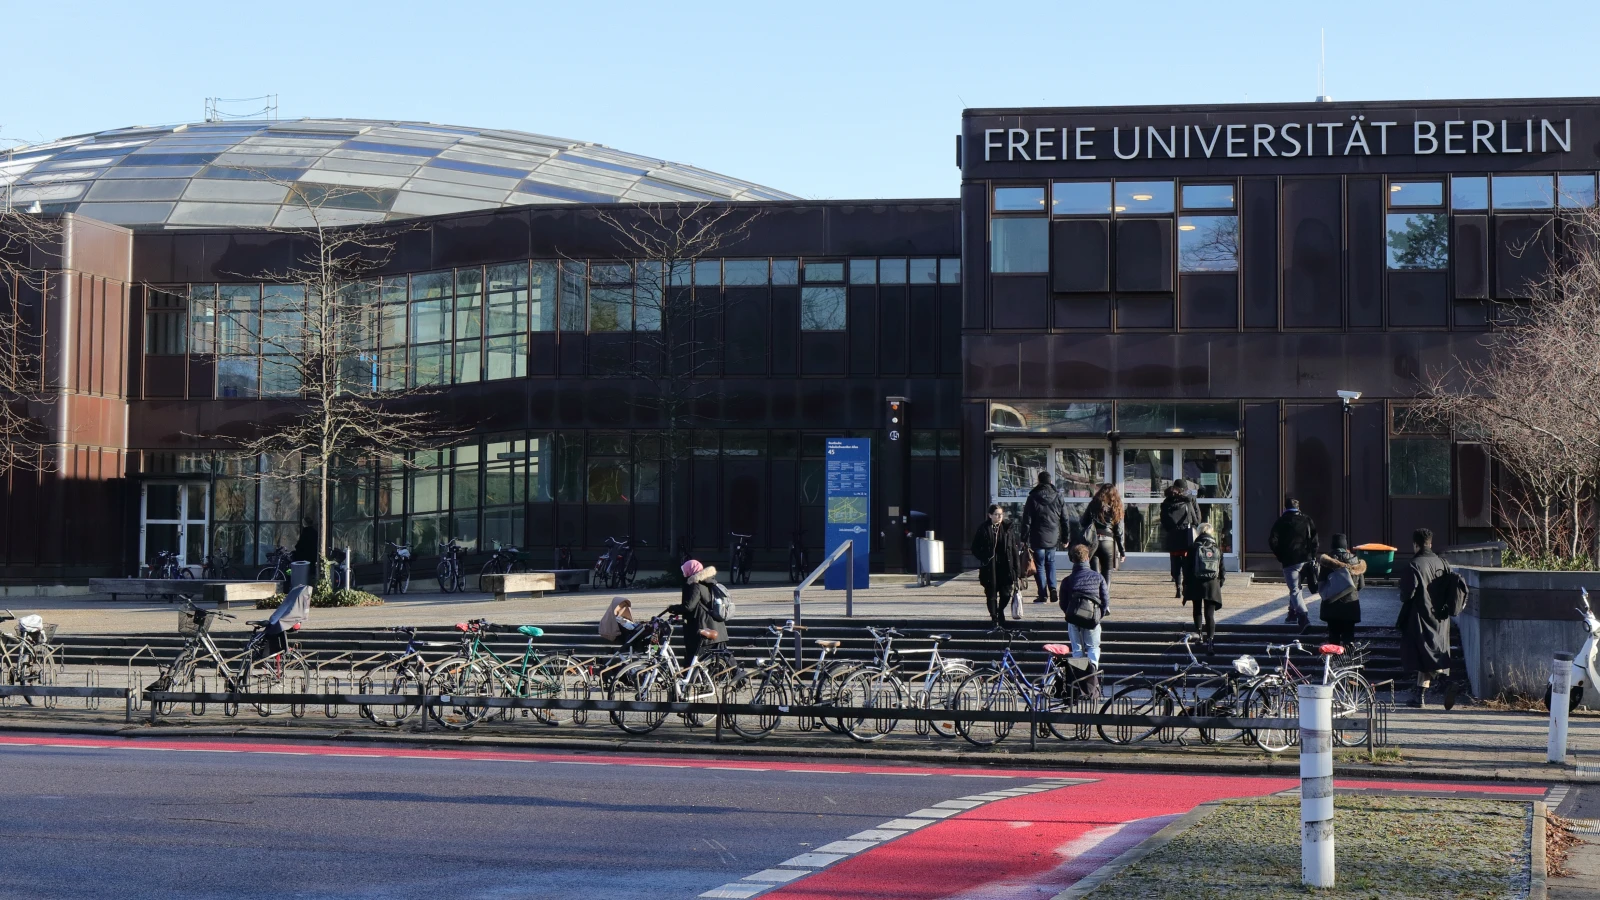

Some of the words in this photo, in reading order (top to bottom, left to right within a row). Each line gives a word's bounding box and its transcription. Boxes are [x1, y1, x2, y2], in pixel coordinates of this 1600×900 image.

[984, 127, 1097, 161] FREIE
[1113, 115, 1398, 159] UNIVERSITÄT
[1414, 118, 1571, 155] BERLIN
